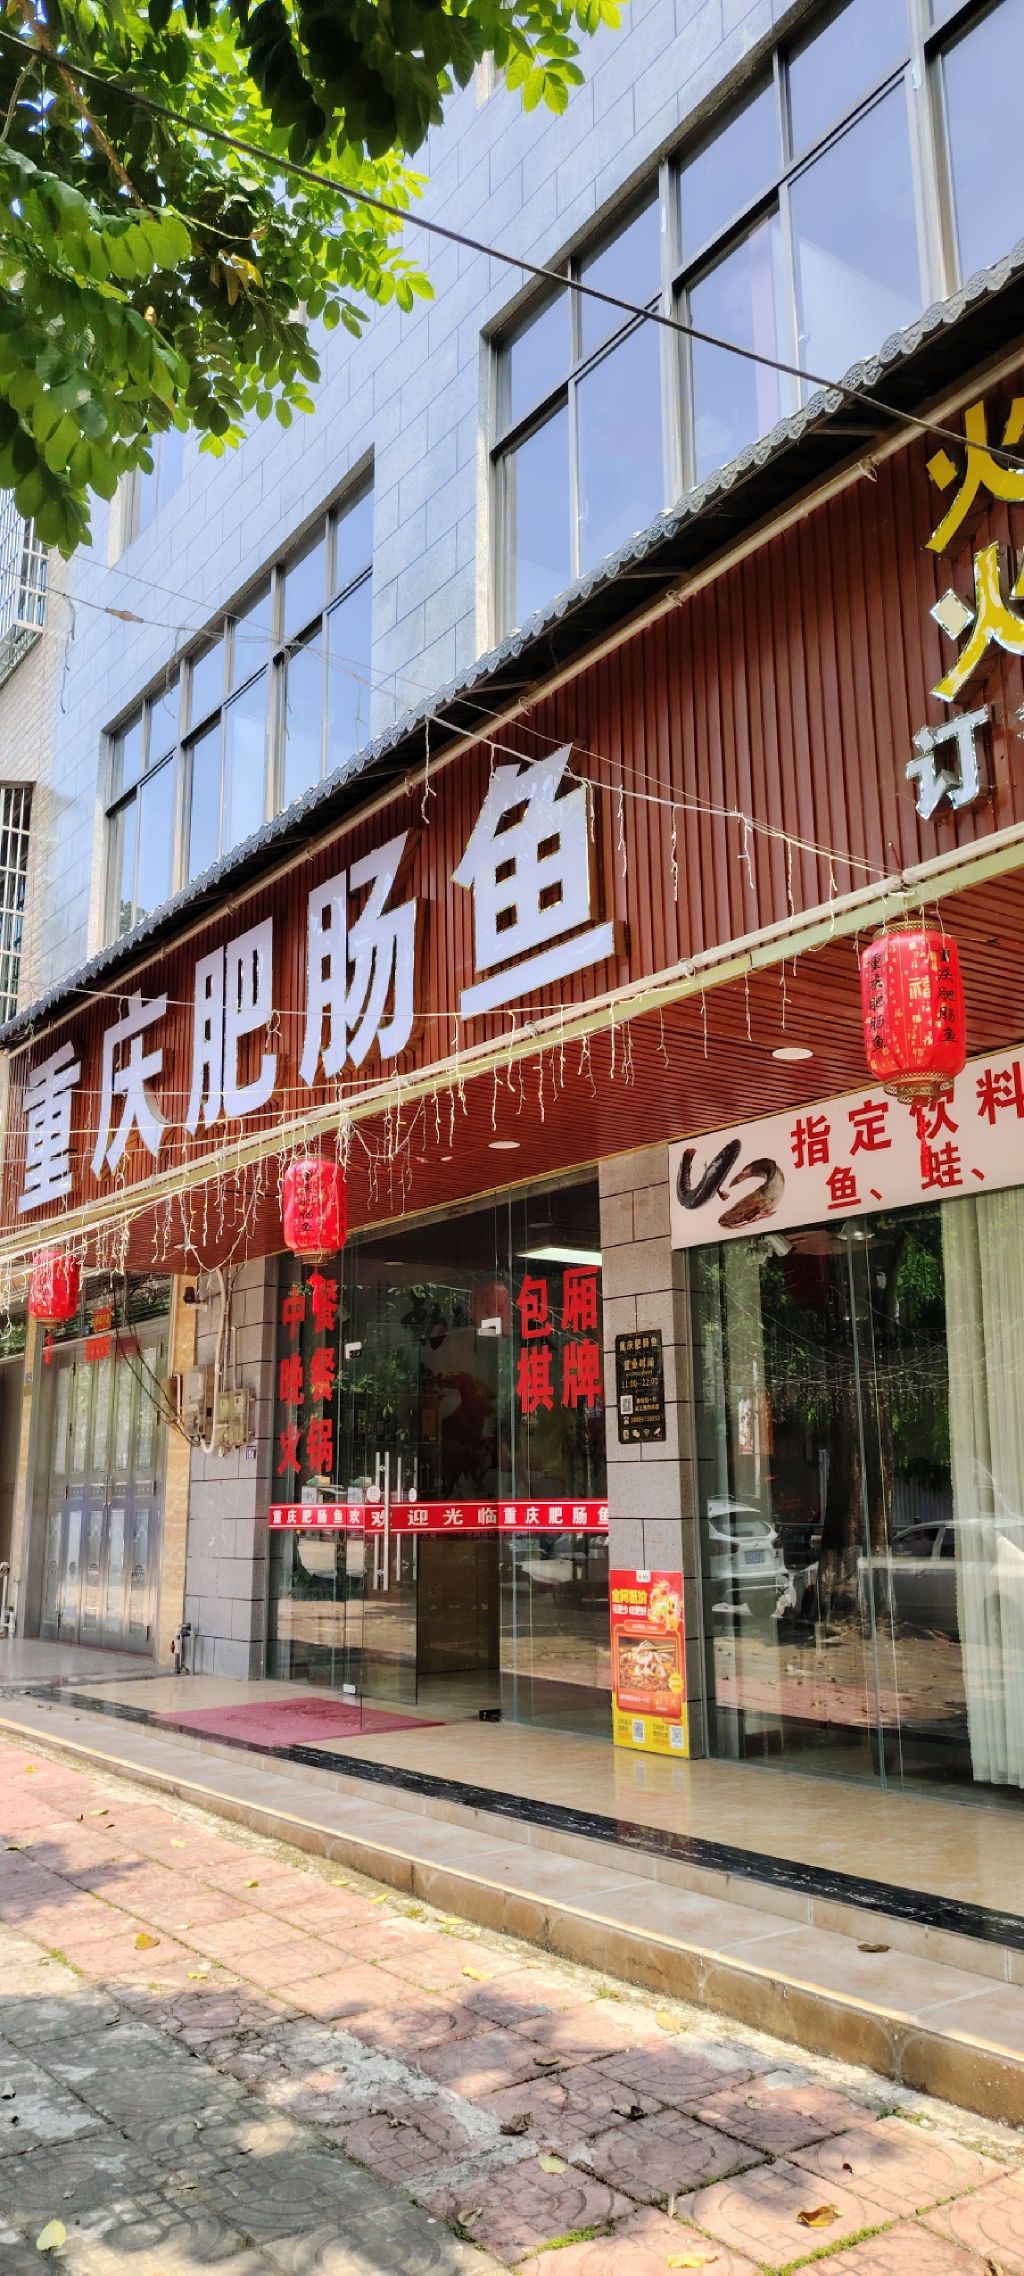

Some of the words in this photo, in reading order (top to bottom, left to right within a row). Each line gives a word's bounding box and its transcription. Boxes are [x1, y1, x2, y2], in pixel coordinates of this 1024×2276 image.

[906, 703, 1024, 820] 订
[18, 743, 614, 1214] 重庆肥肠鱼
[516, 1265, 602, 1340] 包厢
[279, 1347, 336, 1406] 晚餐
[515, 1338, 602, 1413] 棋牌
[277, 1416, 334, 1475] 火锅
